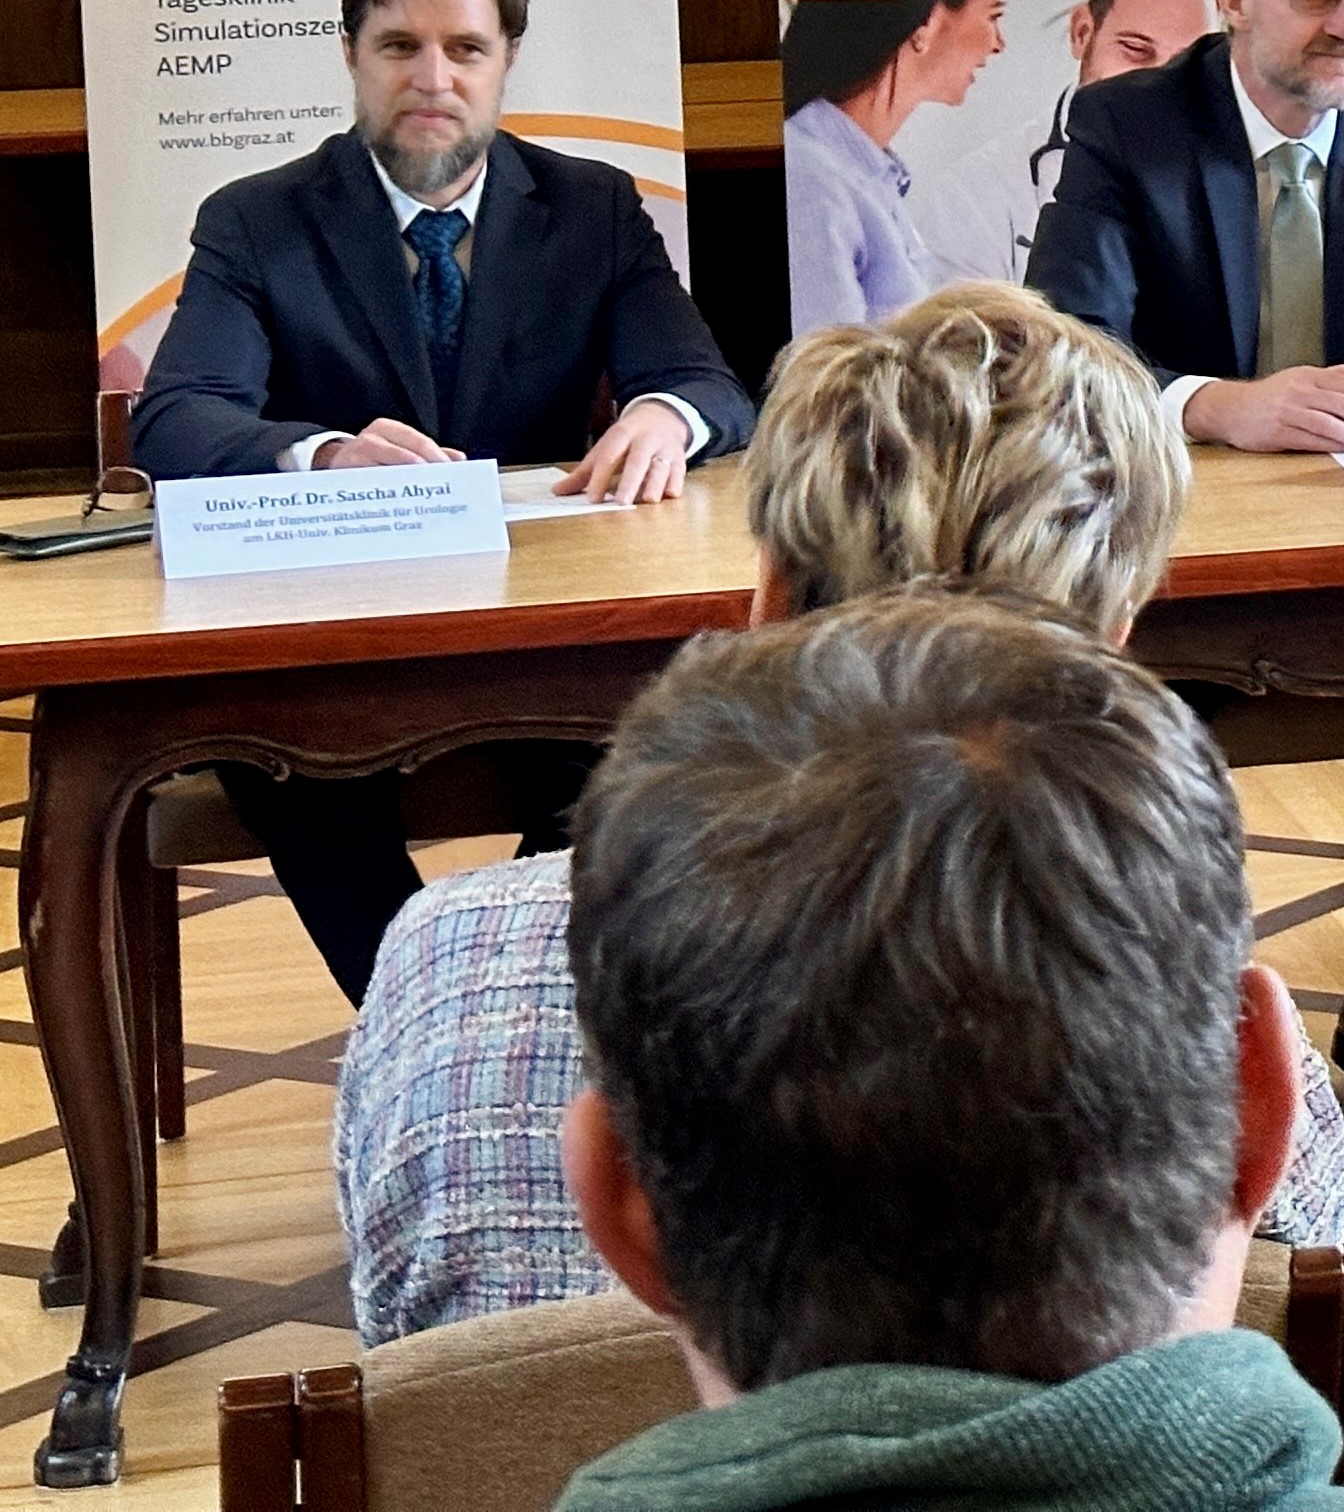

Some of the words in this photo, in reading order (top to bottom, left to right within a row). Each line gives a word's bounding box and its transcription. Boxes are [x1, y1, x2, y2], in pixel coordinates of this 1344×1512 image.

[157, 54, 231, 76] AEMP
[159, 111, 204, 125] Mehr
[209, 108, 284, 123] erfahren
[290, 106, 341, 119] unter:
[159, 131, 294, 149] www.bbgraz.at
[205, 492, 302, 513] Univ.-Prof.
[306, 491, 334, 506] Dr.
[336, 486, 397, 503] Sascha
[401, 482, 452, 501] Ahyai
[192, 518, 251, 533] Vorstand
[254, 515, 276, 529] der
[393, 505, 413, 519] für
